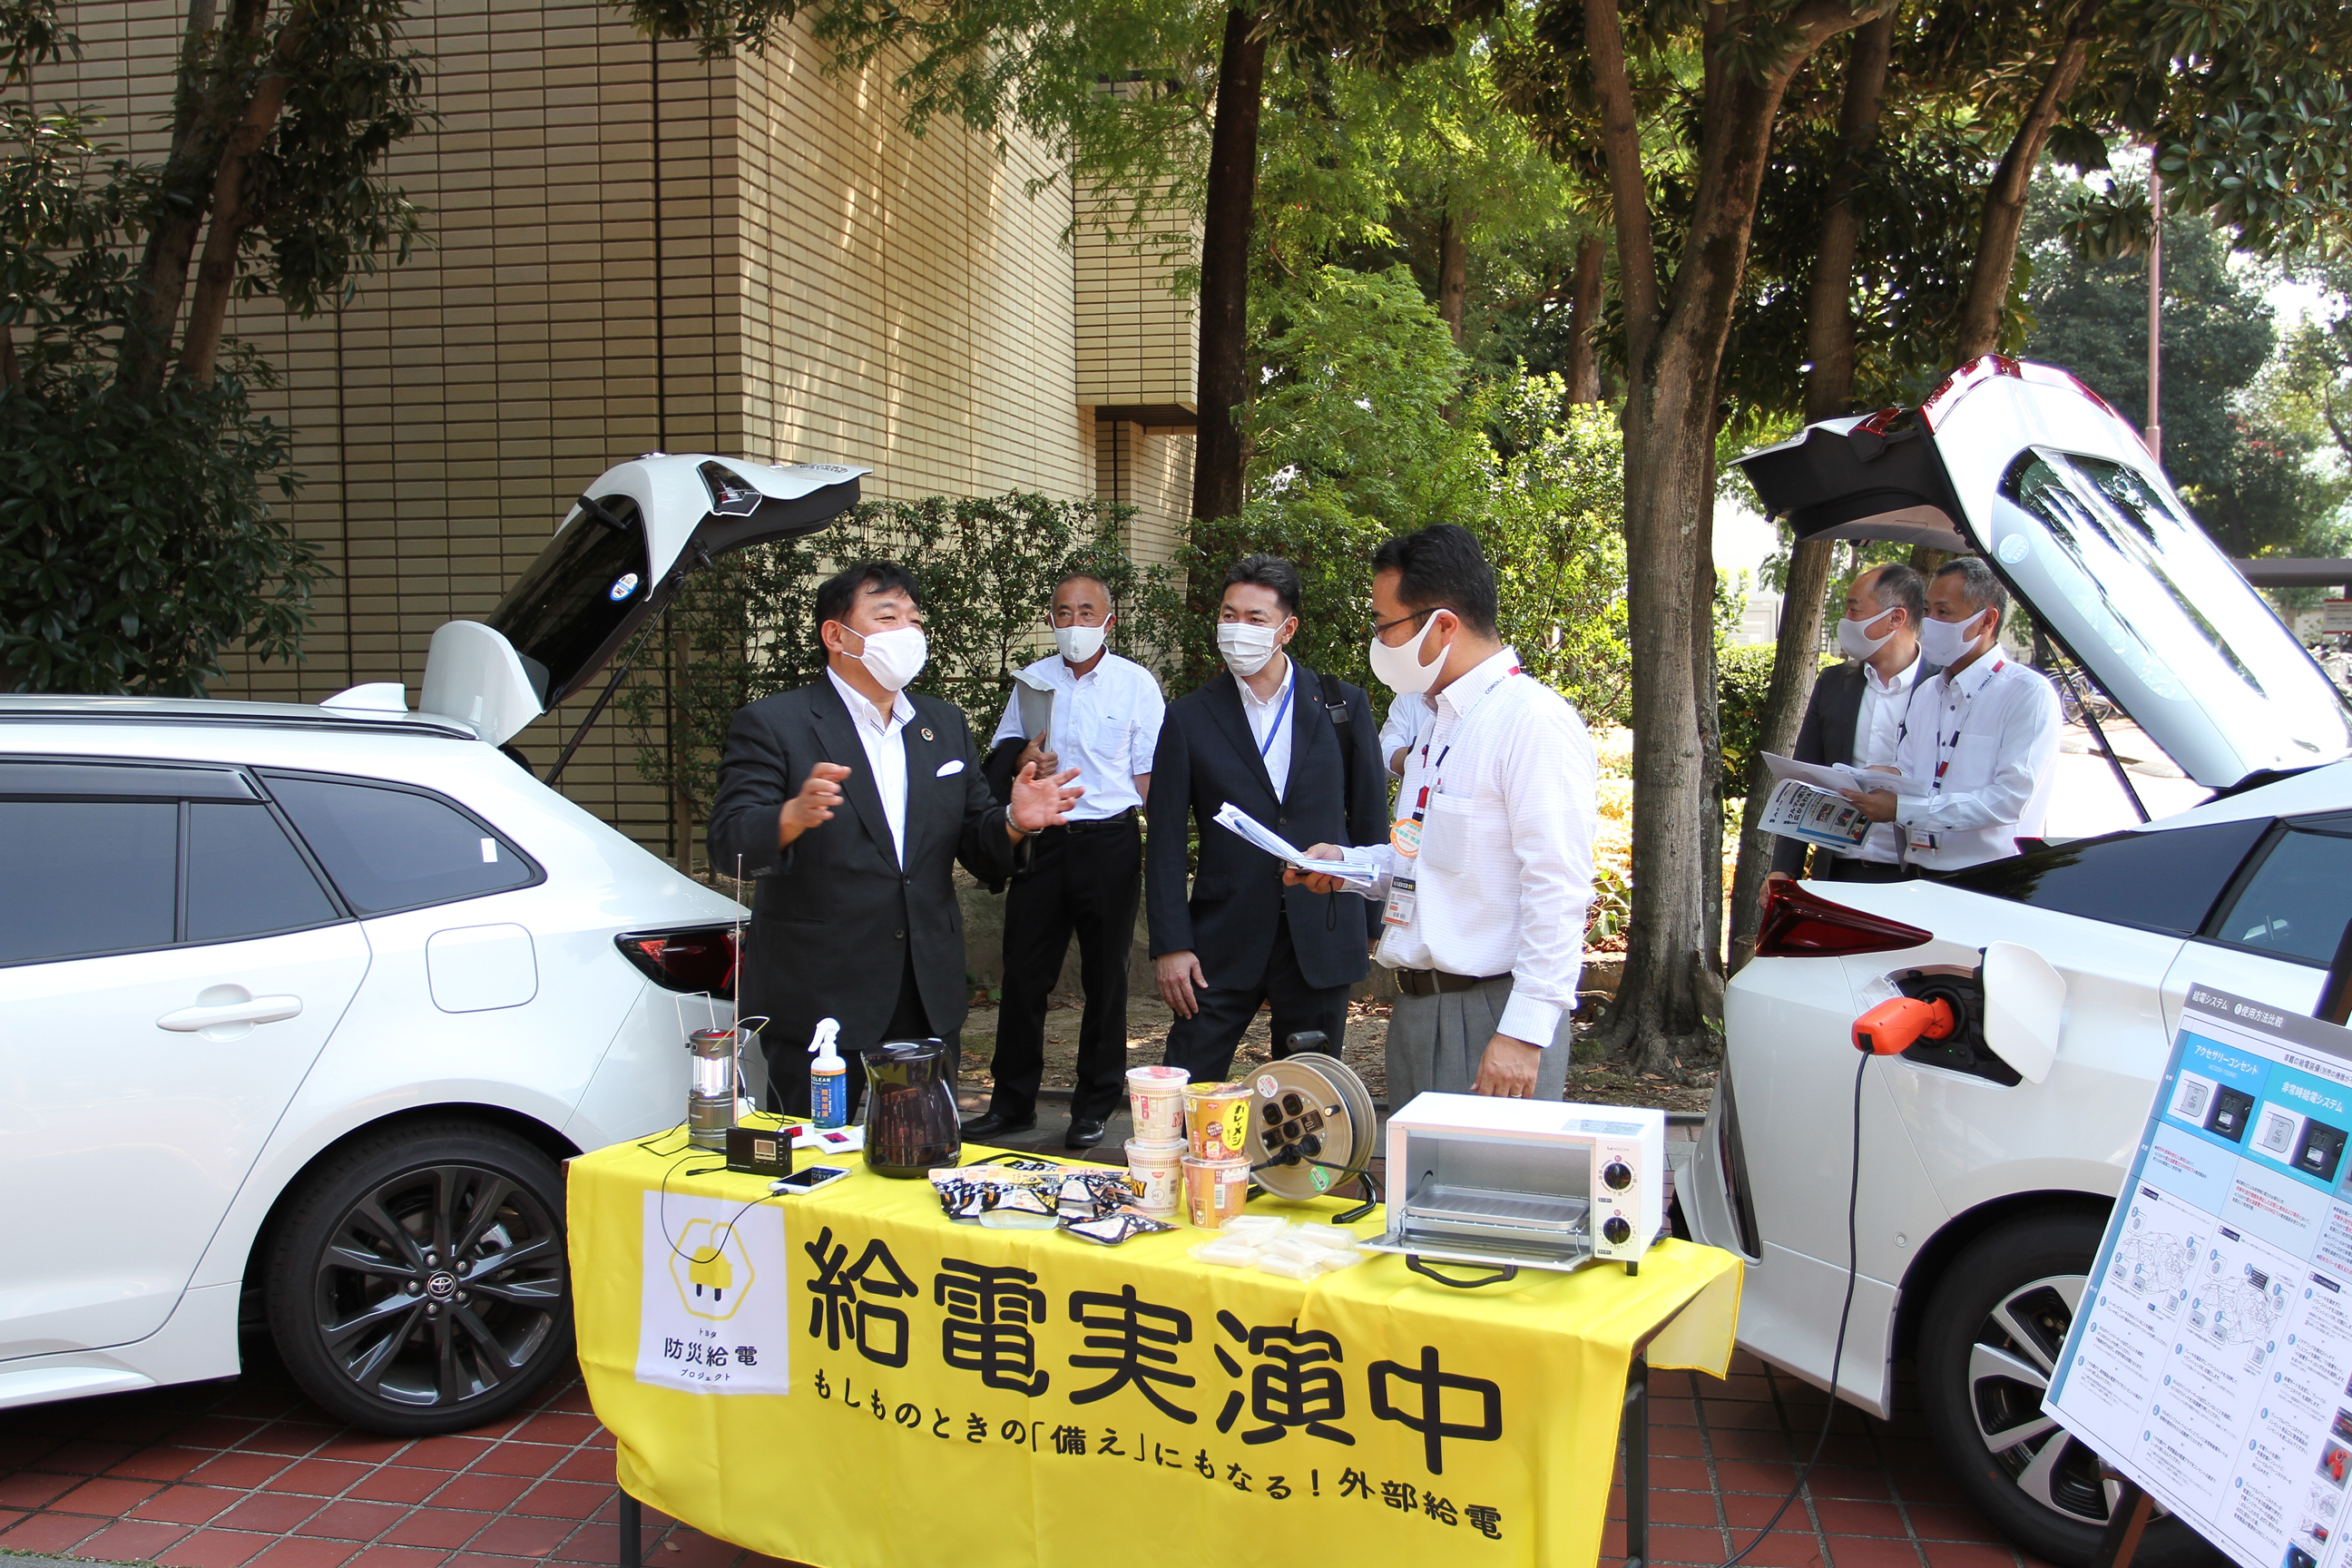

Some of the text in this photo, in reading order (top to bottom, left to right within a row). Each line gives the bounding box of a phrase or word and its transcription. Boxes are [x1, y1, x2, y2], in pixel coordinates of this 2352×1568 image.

[1485, 674, 1507, 696] COROLLA
[1977, 673, 1994, 692] COROLLA
[2190, 990, 2230, 1011] 給電システム
[2193, 1044, 2259, 1076] アクセサリーコンセント
[2279, 1081, 2345, 1113] 非常時給電システム
[1231, 1104, 1245, 1147] カレーメシ
[698, 1327, 718, 1339] トヨタ
[663, 1336, 758, 1367] 防災給電
[805, 1226, 1503, 1475] 給電実演中
[679, 1369, 731, 1383] プロジェクト
